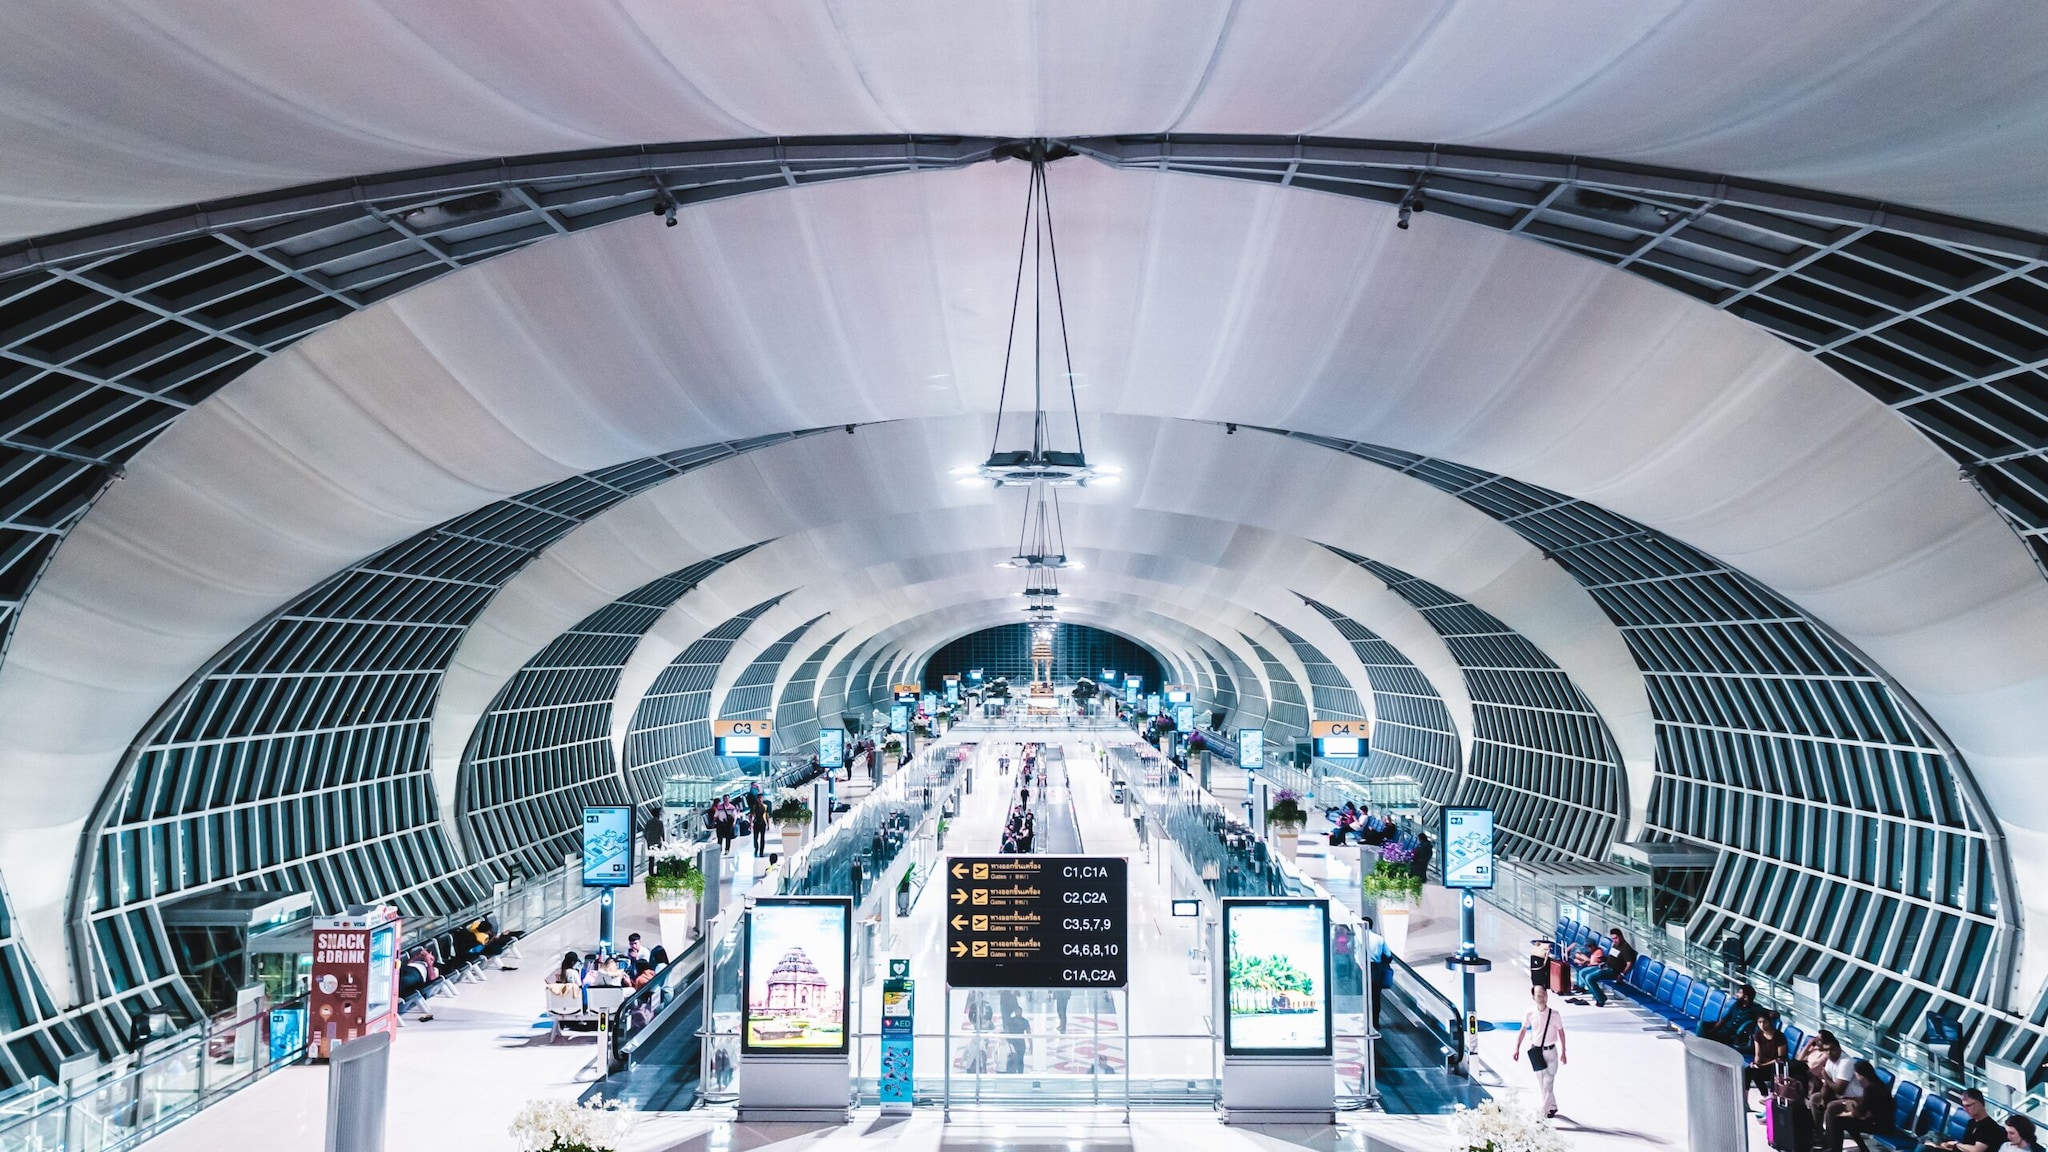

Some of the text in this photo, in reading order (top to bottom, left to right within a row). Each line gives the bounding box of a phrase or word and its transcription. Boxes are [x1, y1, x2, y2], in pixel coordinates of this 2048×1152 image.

[733, 723, 752, 734] C3
[1331, 724, 1350, 735] C4
[1063, 866, 1108, 879] C1,C1A
[1063, 892, 1108, 905] C2,C2A
[1063, 918, 1111, 931] C3,5,7,9
[318, 934, 365, 949] SNACK
[317, 950, 365, 964] &DRINK
[1063, 944, 1118, 957] C4,6,8,10
[1063, 970, 1116, 982] C1A,C2A
